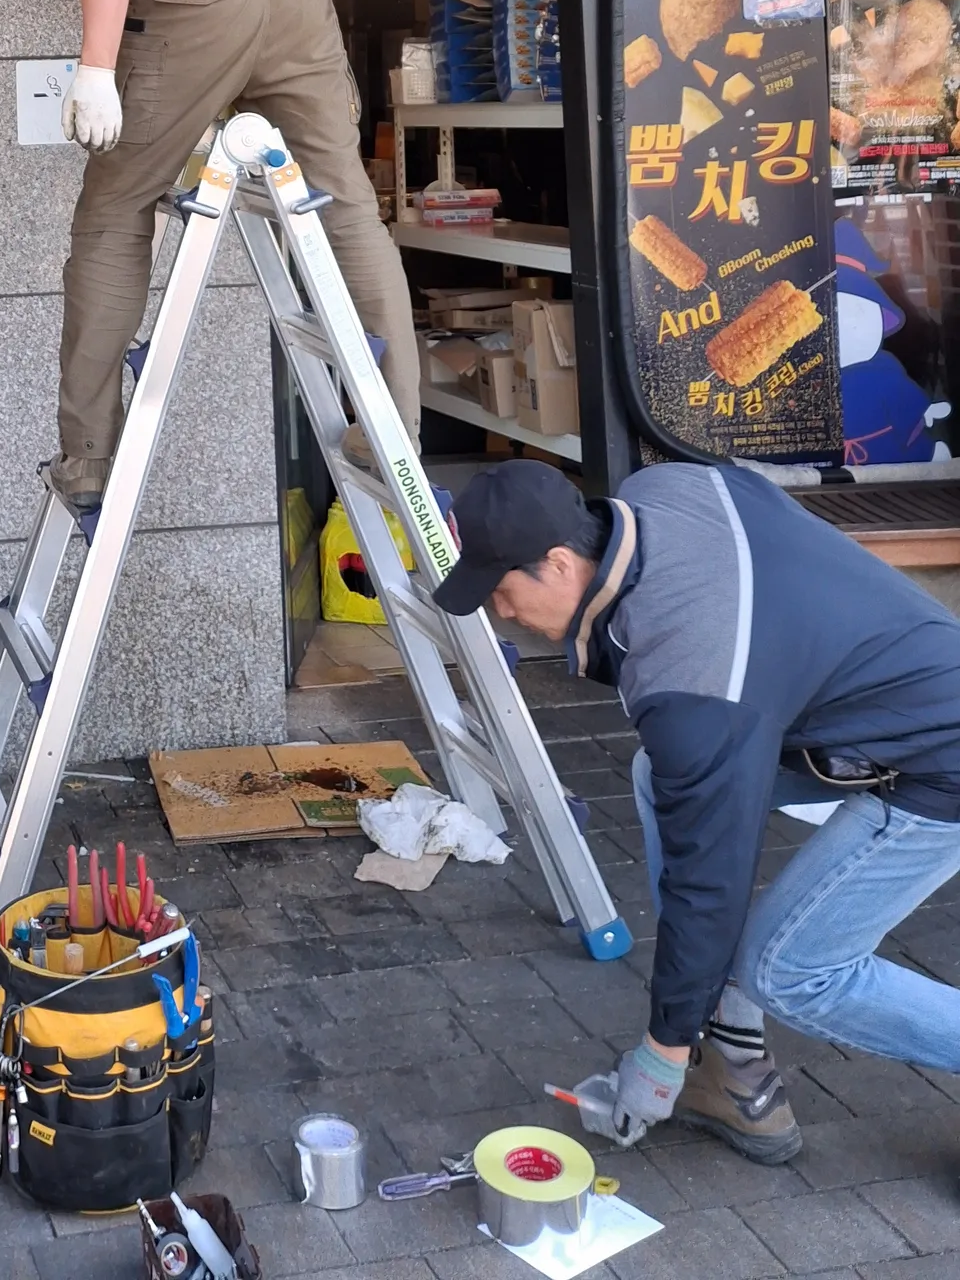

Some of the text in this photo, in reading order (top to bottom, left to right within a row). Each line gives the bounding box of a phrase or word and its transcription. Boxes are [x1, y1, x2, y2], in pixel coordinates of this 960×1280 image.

[718, 234, 815, 278] BBoom Cheeking
[657, 291, 722, 344] And
